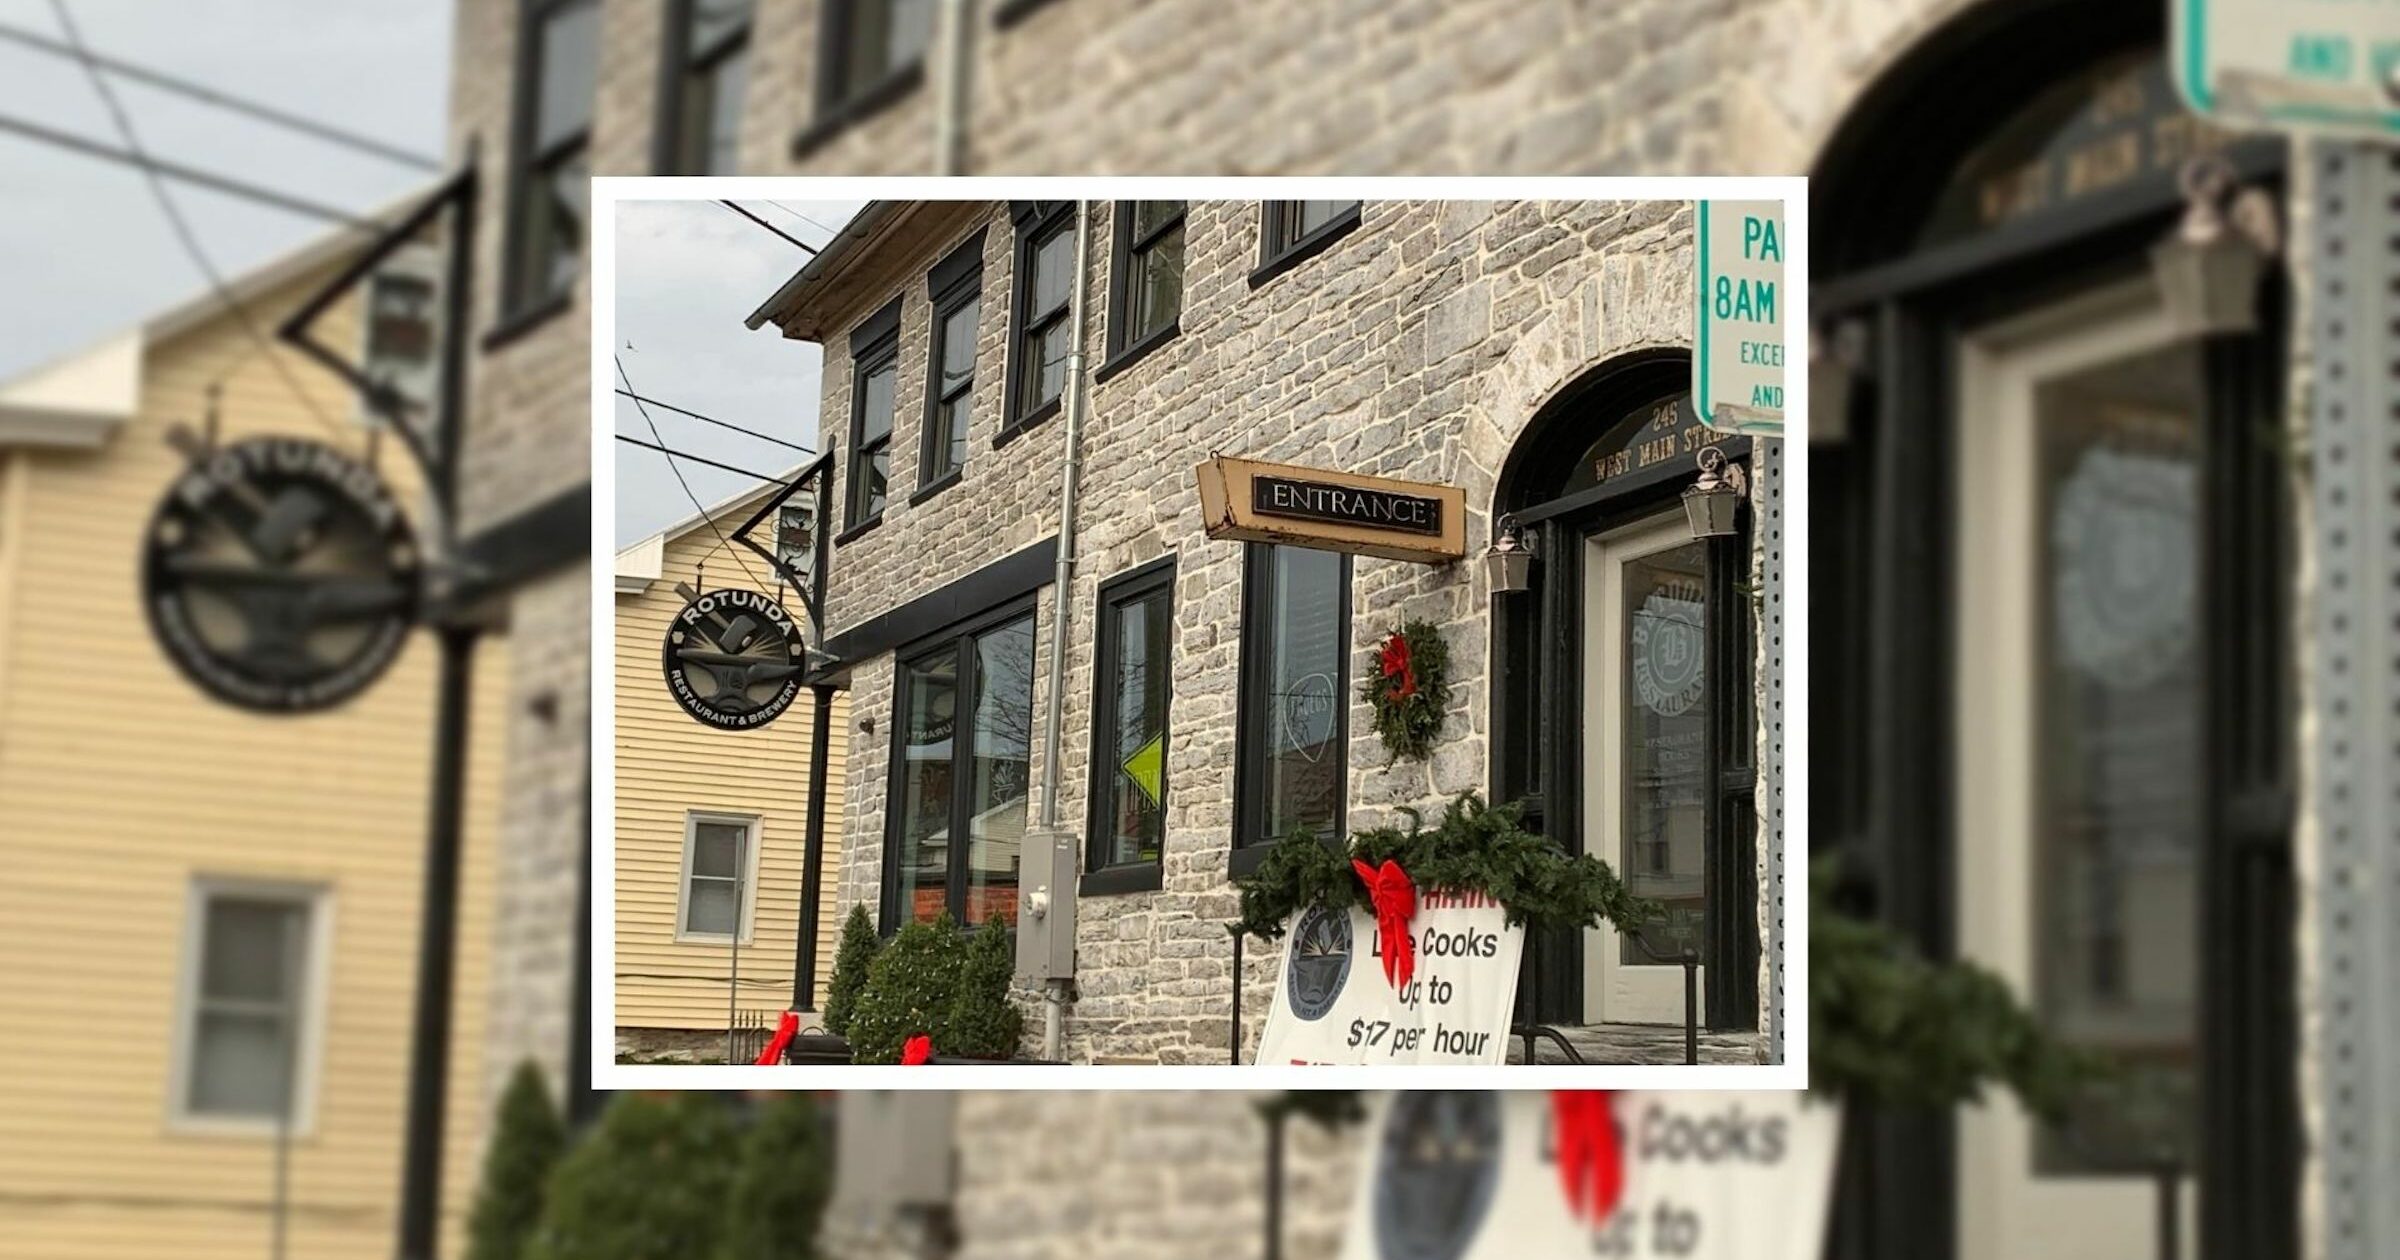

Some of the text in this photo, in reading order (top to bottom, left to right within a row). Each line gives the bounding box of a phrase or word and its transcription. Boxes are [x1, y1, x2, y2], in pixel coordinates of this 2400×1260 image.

[1744, 217, 1784, 262] PA
[1715, 275, 1775, 324] 8AM
[1741, 341, 1784, 367] EXCE
[1751, 384, 1784, 408] AND
[1653, 402, 1678, 432] 245
[1594, 449, 1632, 482] WEST
[1639, 433, 1676, 468] MAIN
[1273, 483, 1426, 524] ENTRANCE
[683, 591, 793, 636] ROTUNDA
[672, 669, 797, 725] RESTAURANT & BREWERY
[1372, 927, 1498, 957] Le Cooks
[1429, 975, 1452, 1005] to
[1347, 1016, 1490, 1056] $17 per hour
